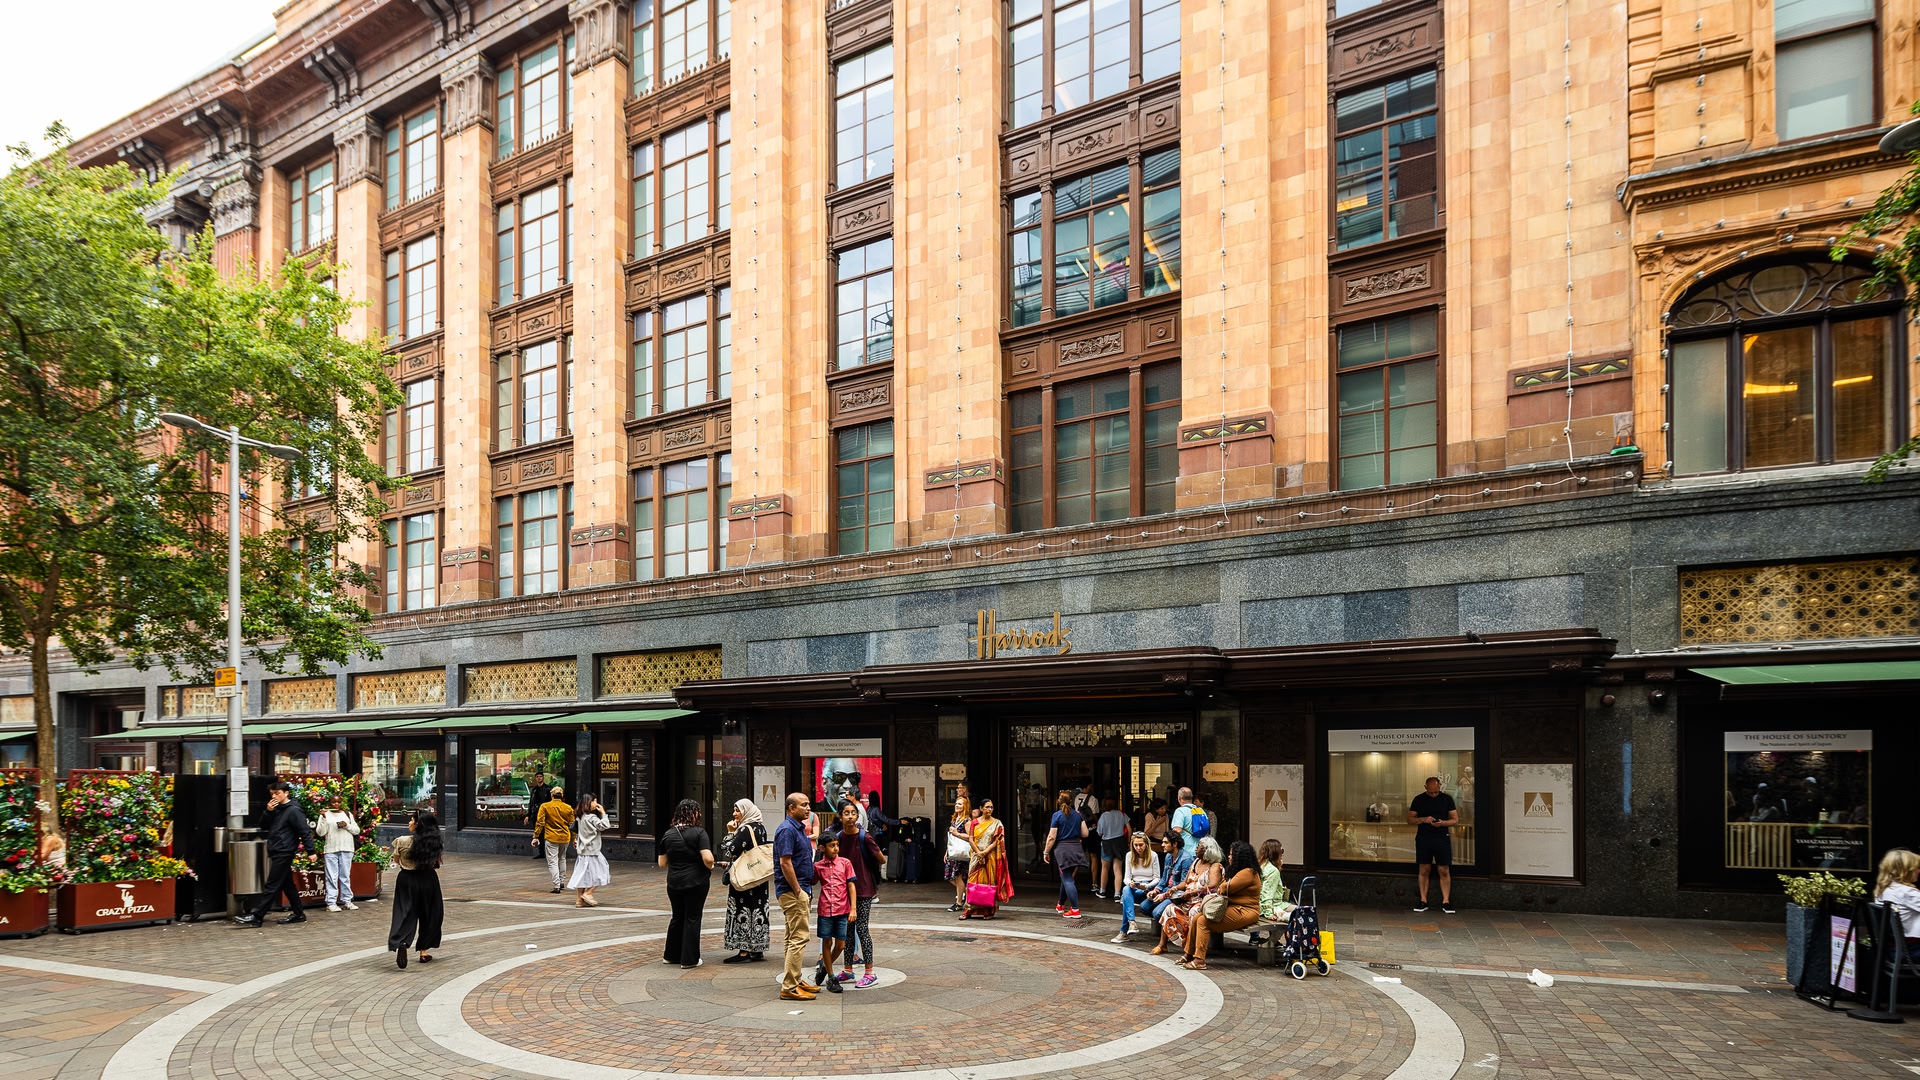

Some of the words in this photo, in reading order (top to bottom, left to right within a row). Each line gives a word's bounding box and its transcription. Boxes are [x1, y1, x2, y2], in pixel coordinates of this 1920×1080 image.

[966, 608, 1073, 659] Harrods
[600, 753, 619, 762] ATM
[96, 906, 126, 916] CRAZY
[128, 905, 154, 914] PIZZA
